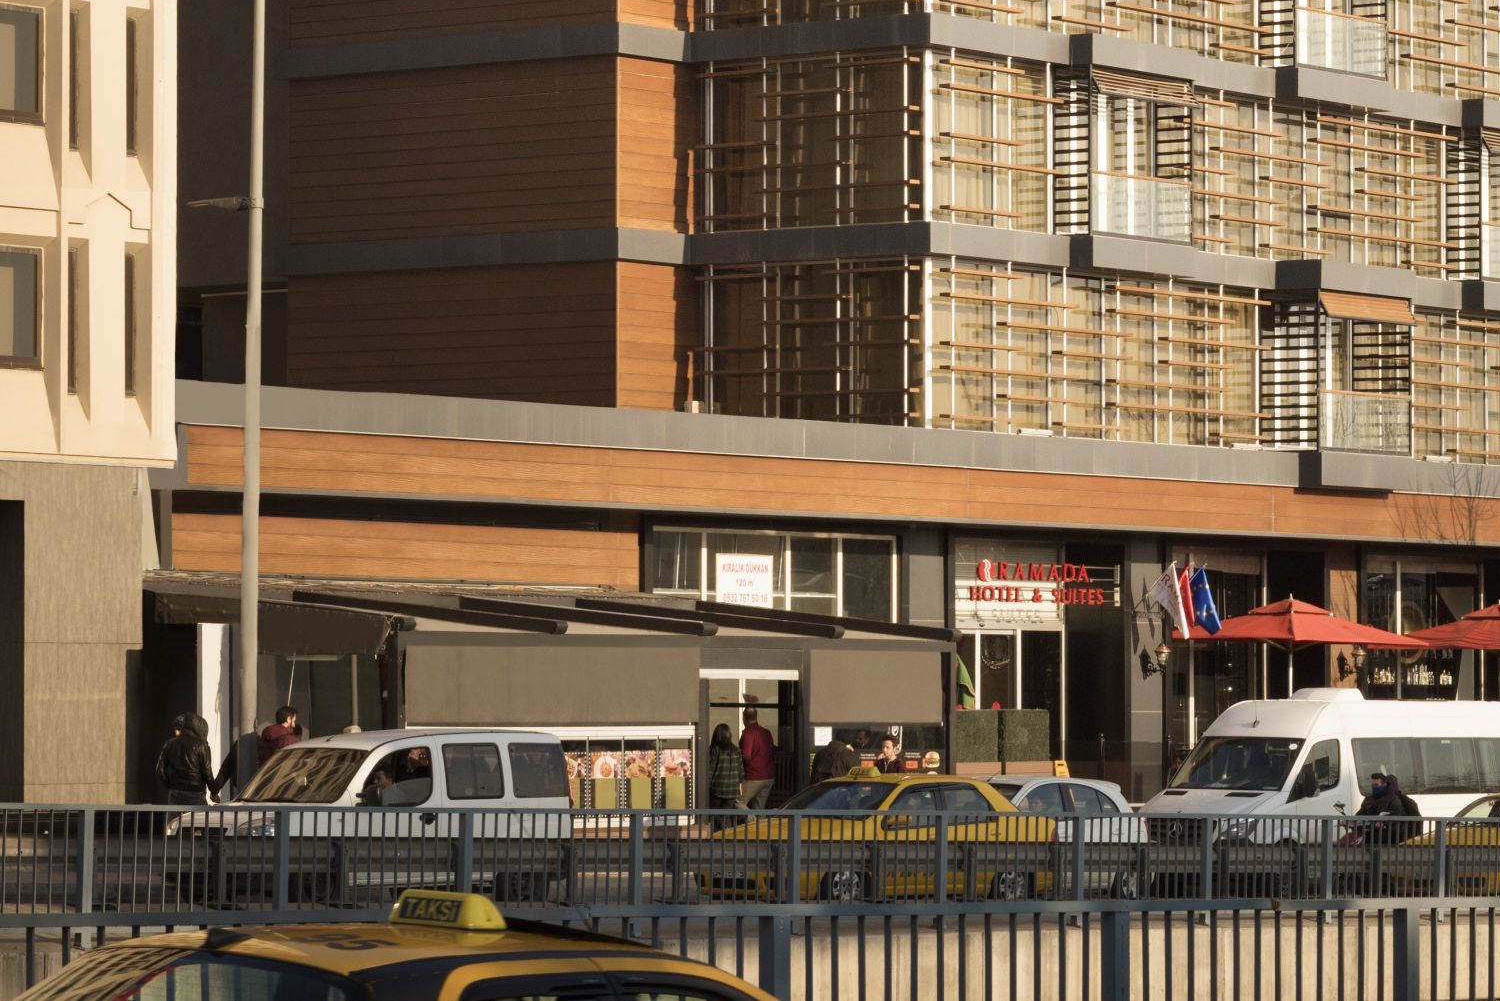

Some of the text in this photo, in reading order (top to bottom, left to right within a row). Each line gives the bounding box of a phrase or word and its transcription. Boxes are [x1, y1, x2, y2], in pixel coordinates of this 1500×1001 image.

[969, 585, 1105, 606] HOTEL & SUITES
